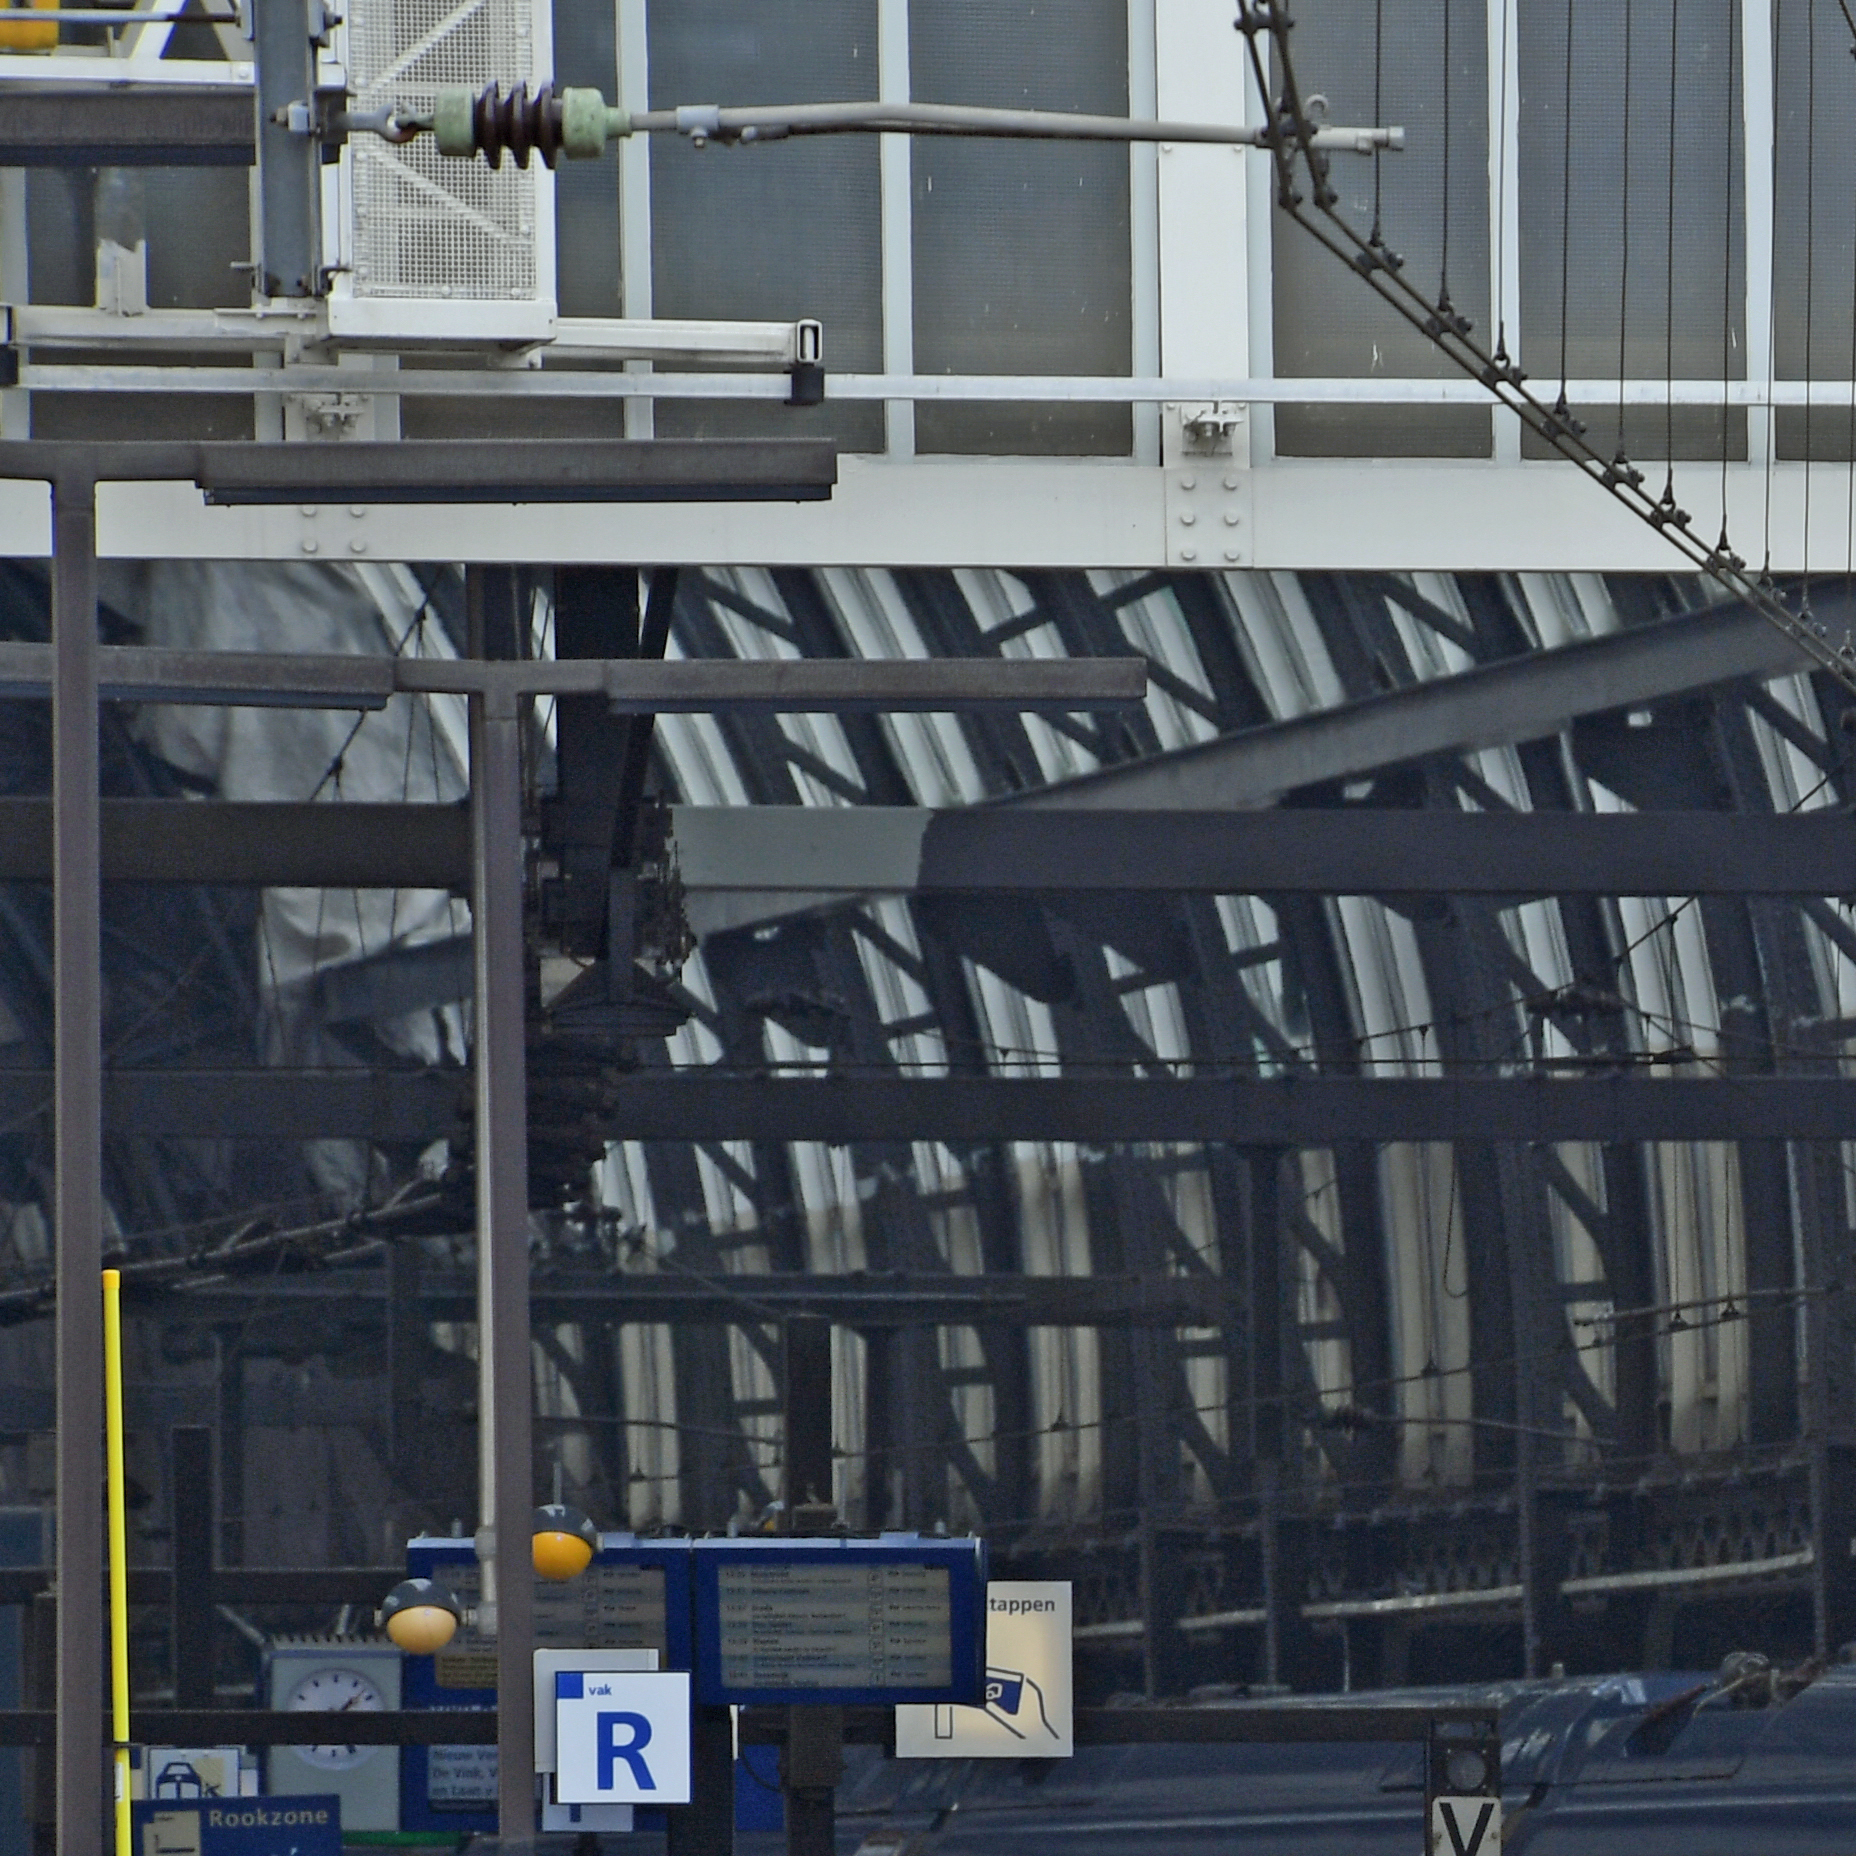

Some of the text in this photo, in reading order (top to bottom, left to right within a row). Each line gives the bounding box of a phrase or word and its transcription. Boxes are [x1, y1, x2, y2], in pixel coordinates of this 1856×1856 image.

[588, 1683, 613, 1696] vak
[596, 1711, 657, 1790] R
[209, 1808, 329, 1827] Rookzone
